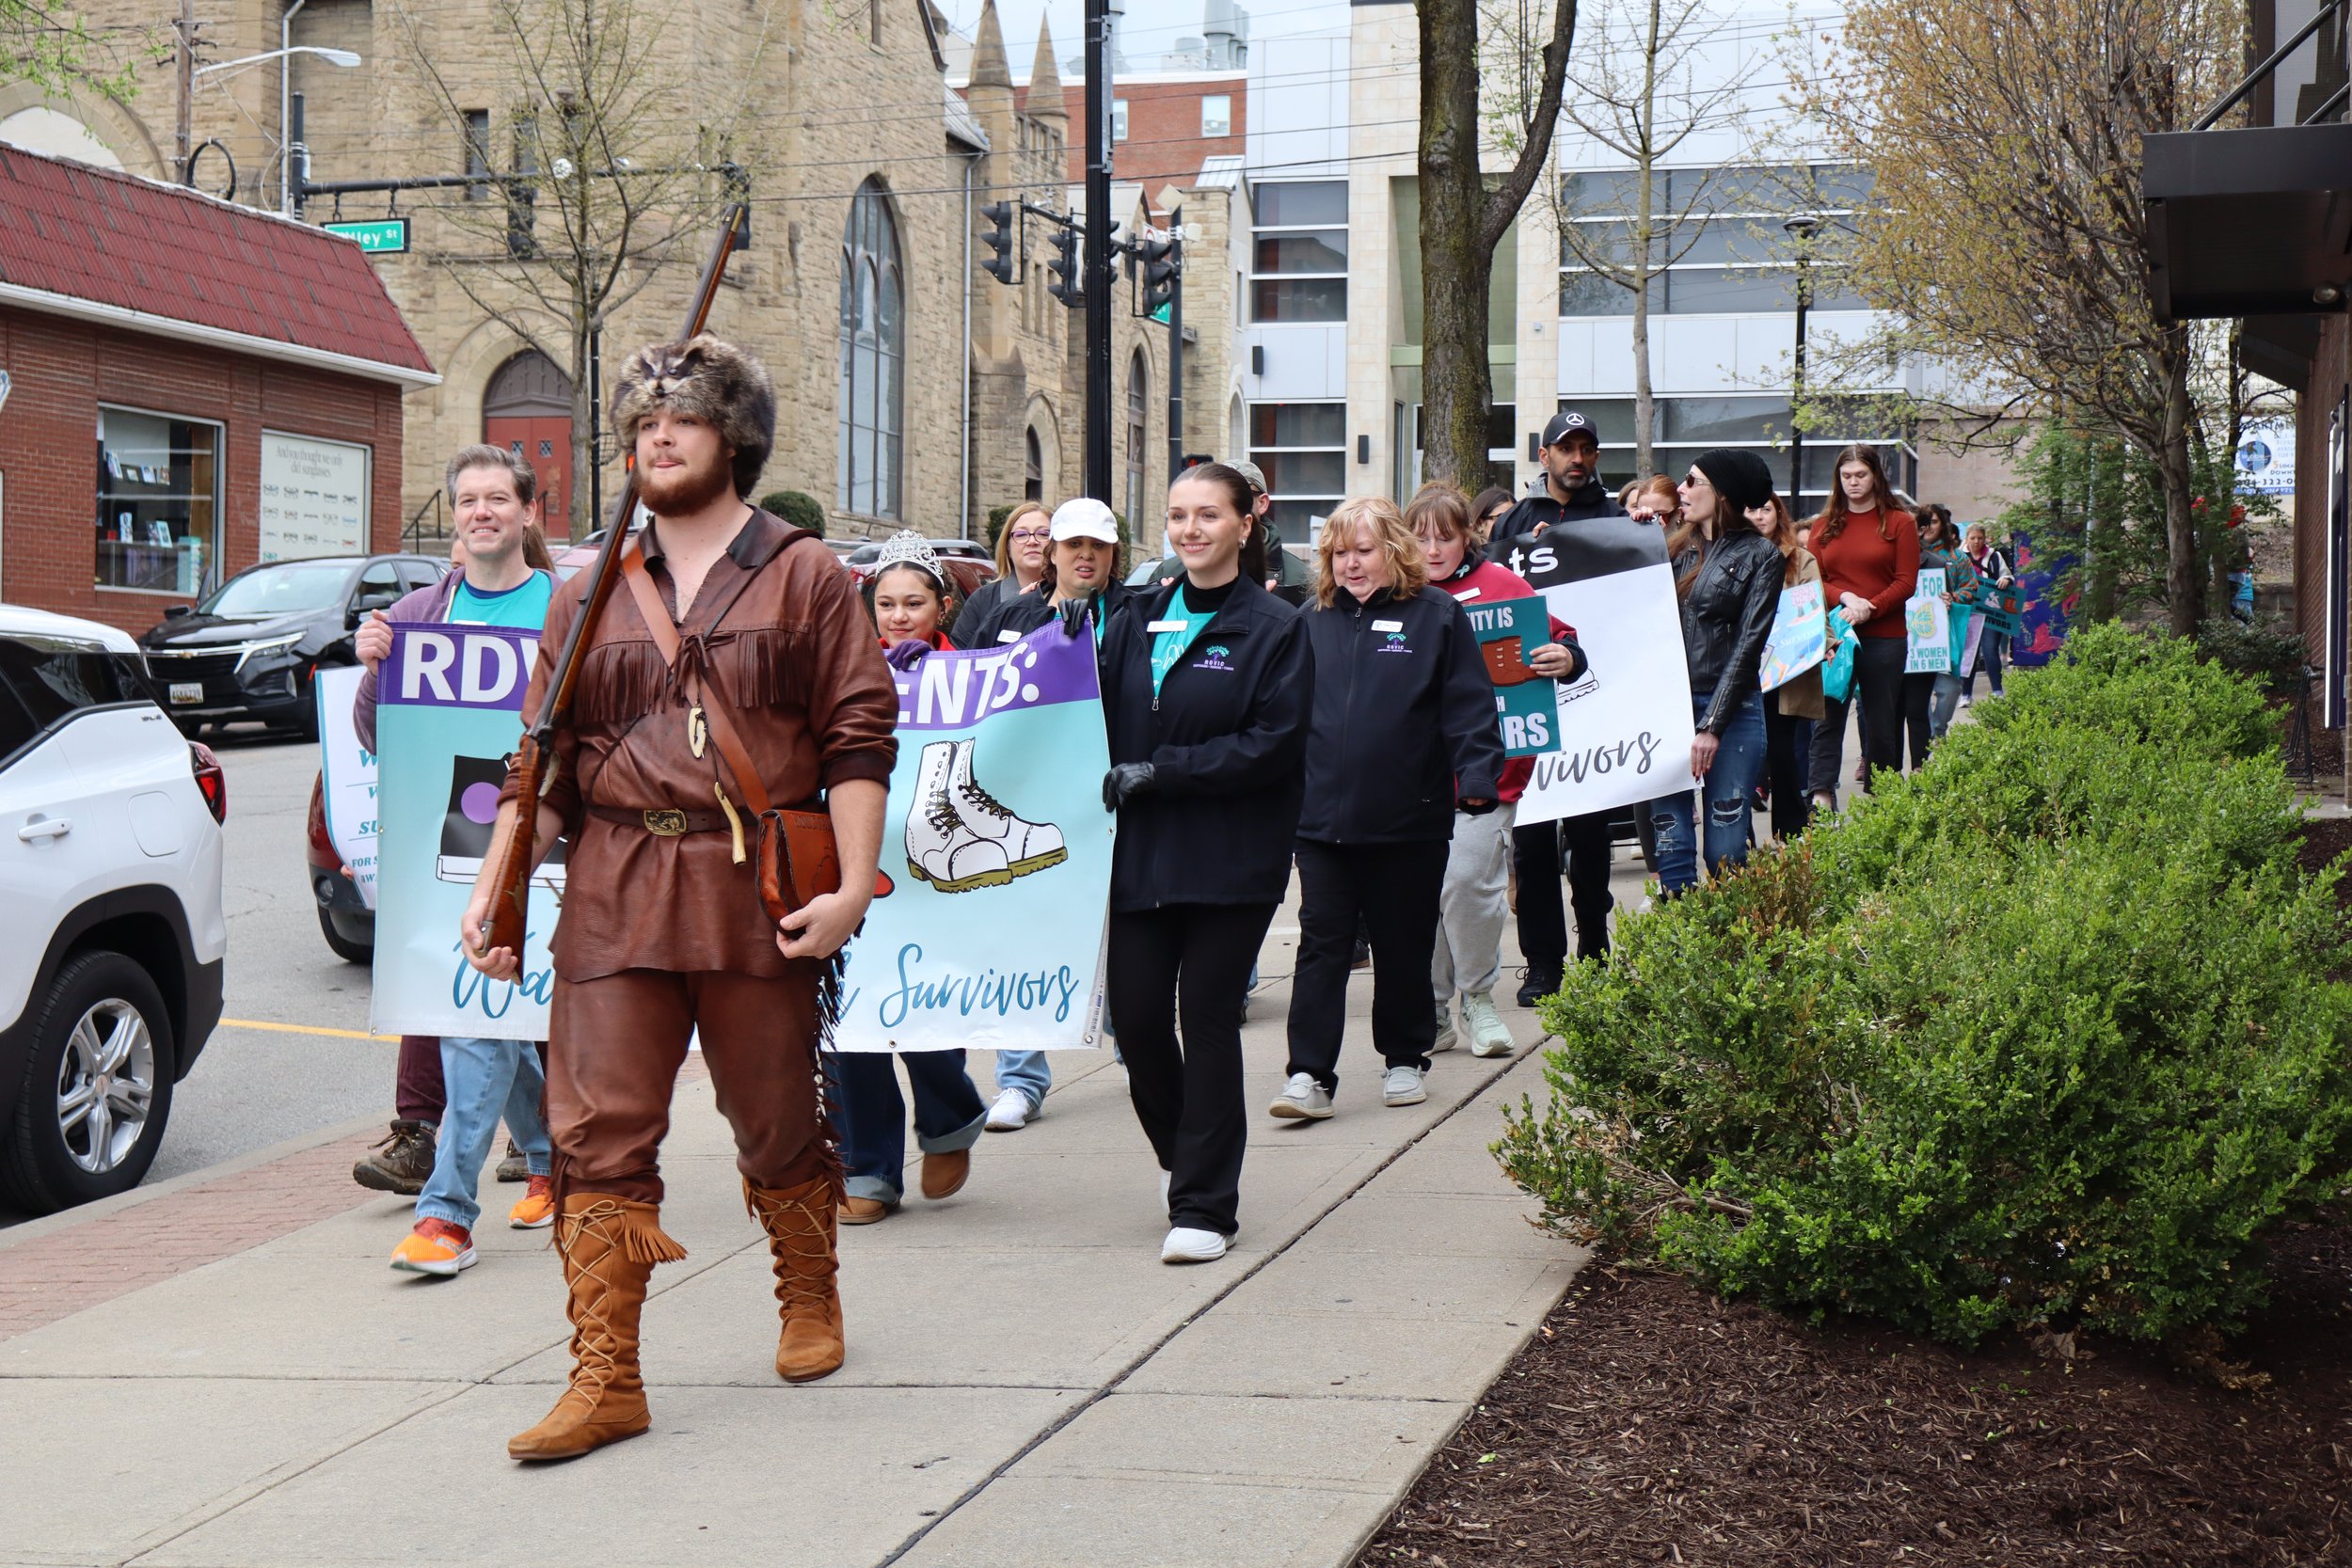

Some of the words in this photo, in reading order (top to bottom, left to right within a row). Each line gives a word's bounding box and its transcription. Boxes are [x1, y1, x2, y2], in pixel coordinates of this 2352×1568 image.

[386, 229, 397, 239] St
[1493, 546, 1559, 578] ts
[1922, 577, 1944, 597] FOR
[1467, 609, 1494, 631] ITY
[1497, 607, 1514, 628] IS
[1916, 647, 1947, 658] WOMEN
[1910, 660, 1919, 671] IN
[1921, 659, 1926, 670] 6
[1928, 658, 1946, 670] MEN
[1500, 712, 1549, 750] RS
[352, 857, 373, 869] FOR
[880, 942, 1079, 1028] Survivors
